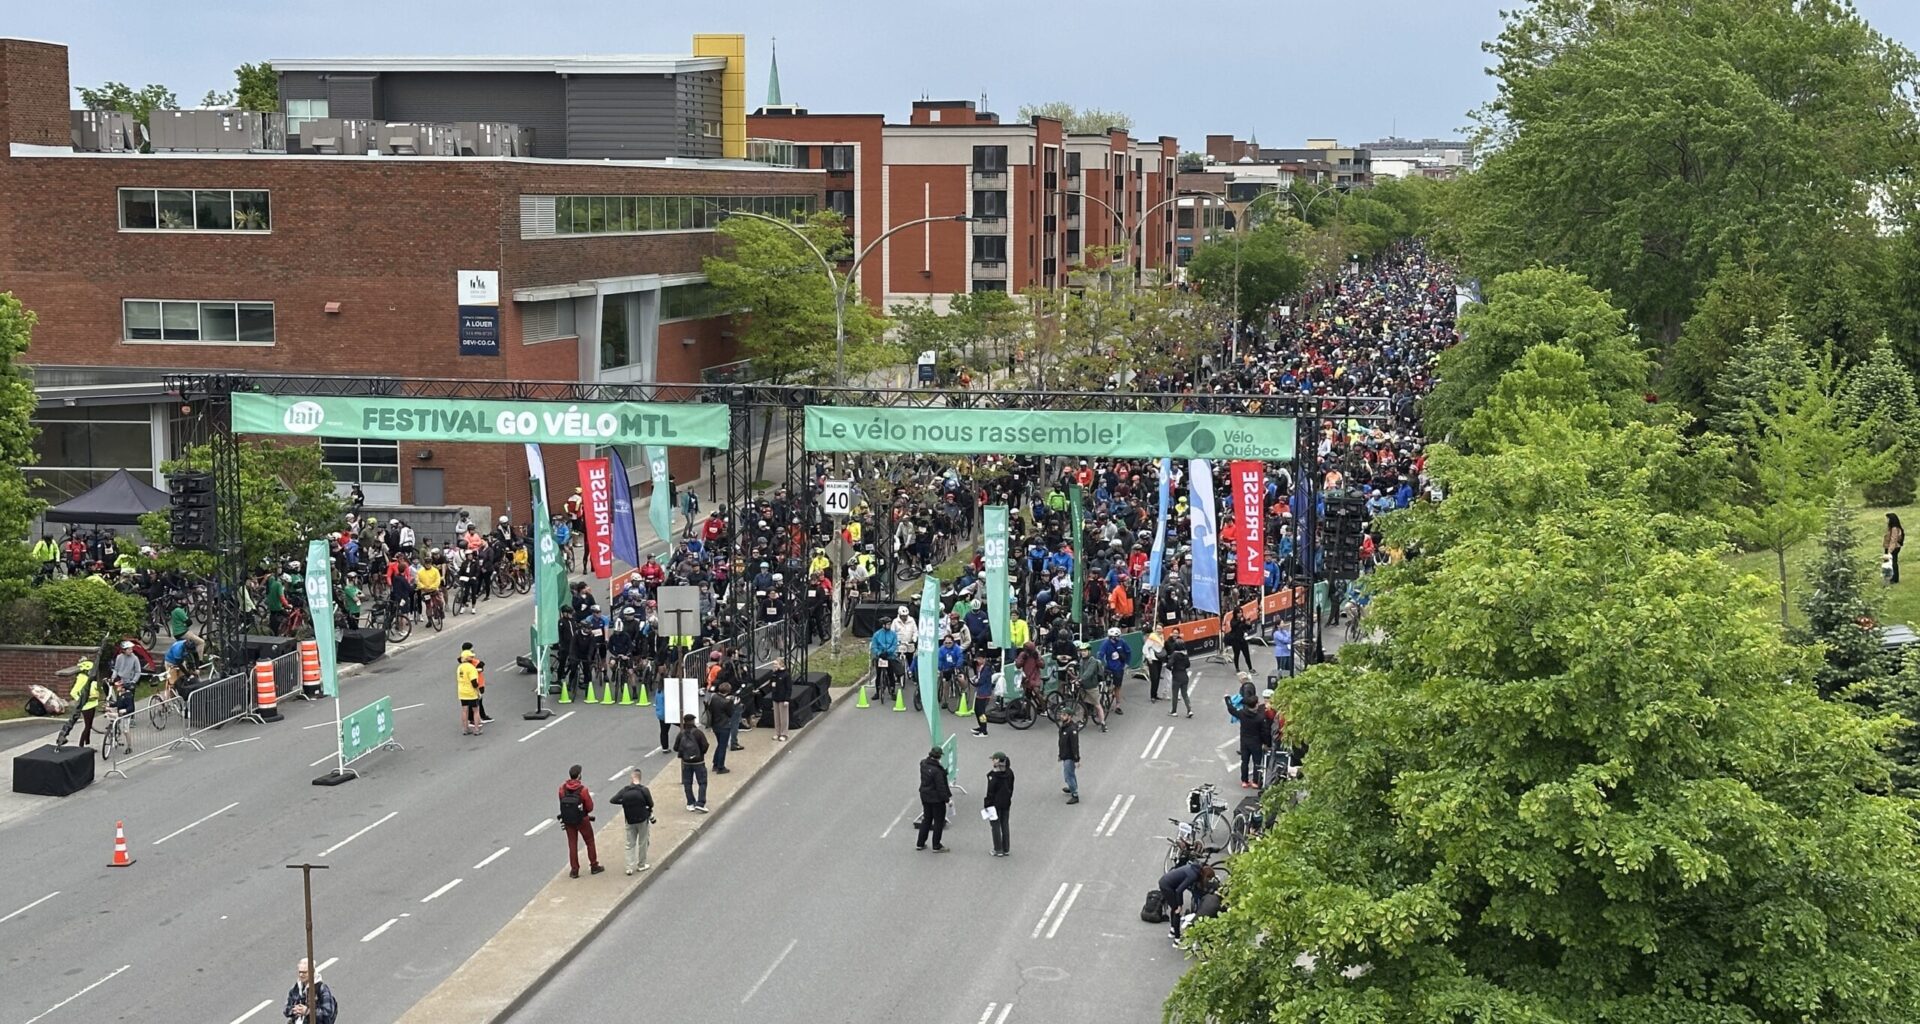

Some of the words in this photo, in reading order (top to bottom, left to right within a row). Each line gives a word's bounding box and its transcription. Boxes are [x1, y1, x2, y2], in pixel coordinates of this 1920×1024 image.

[288, 406, 322, 425] lait
[363, 407, 493, 434] FESTIVAL
[496, 410, 538, 436] GO
[542, 406, 617, 437] VÉLO
[619, 412, 677, 438] MTL
[818, 417, 848, 438] Le
[852, 417, 906, 440] vélo
[912, 423, 973, 442] nous
[979, 421, 1122, 446] rassemble!
[1223, 430, 1254, 444] Vélo
[1222, 443, 1280, 459] Québec
[826, 492, 849, 509] 40
